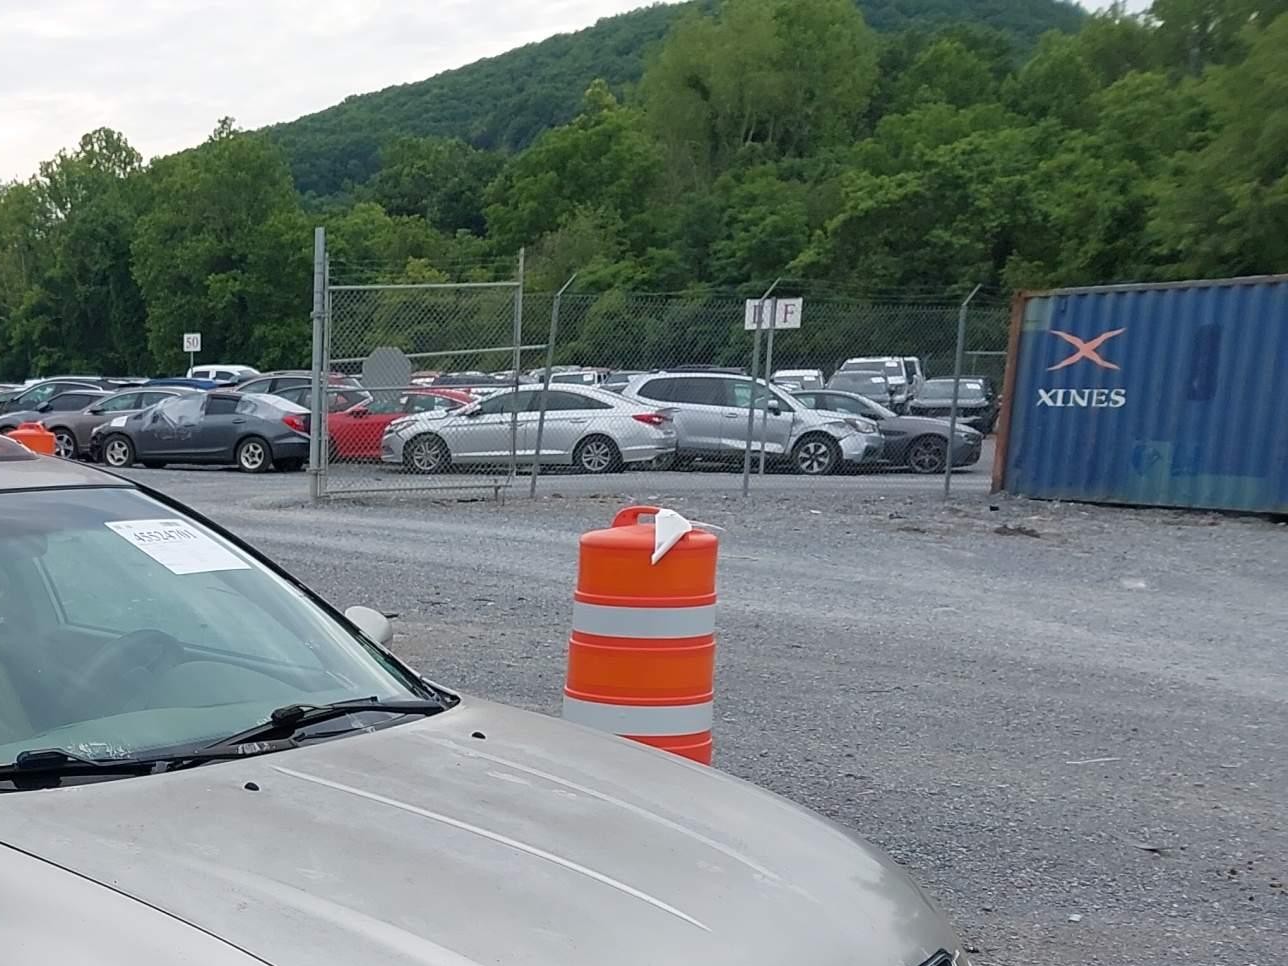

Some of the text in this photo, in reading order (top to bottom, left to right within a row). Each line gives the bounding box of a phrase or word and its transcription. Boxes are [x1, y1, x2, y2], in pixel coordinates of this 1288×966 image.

[783, 303, 796, 323] F
[186, 336, 199, 349] 50
[1036, 388, 1127, 408] XINES
